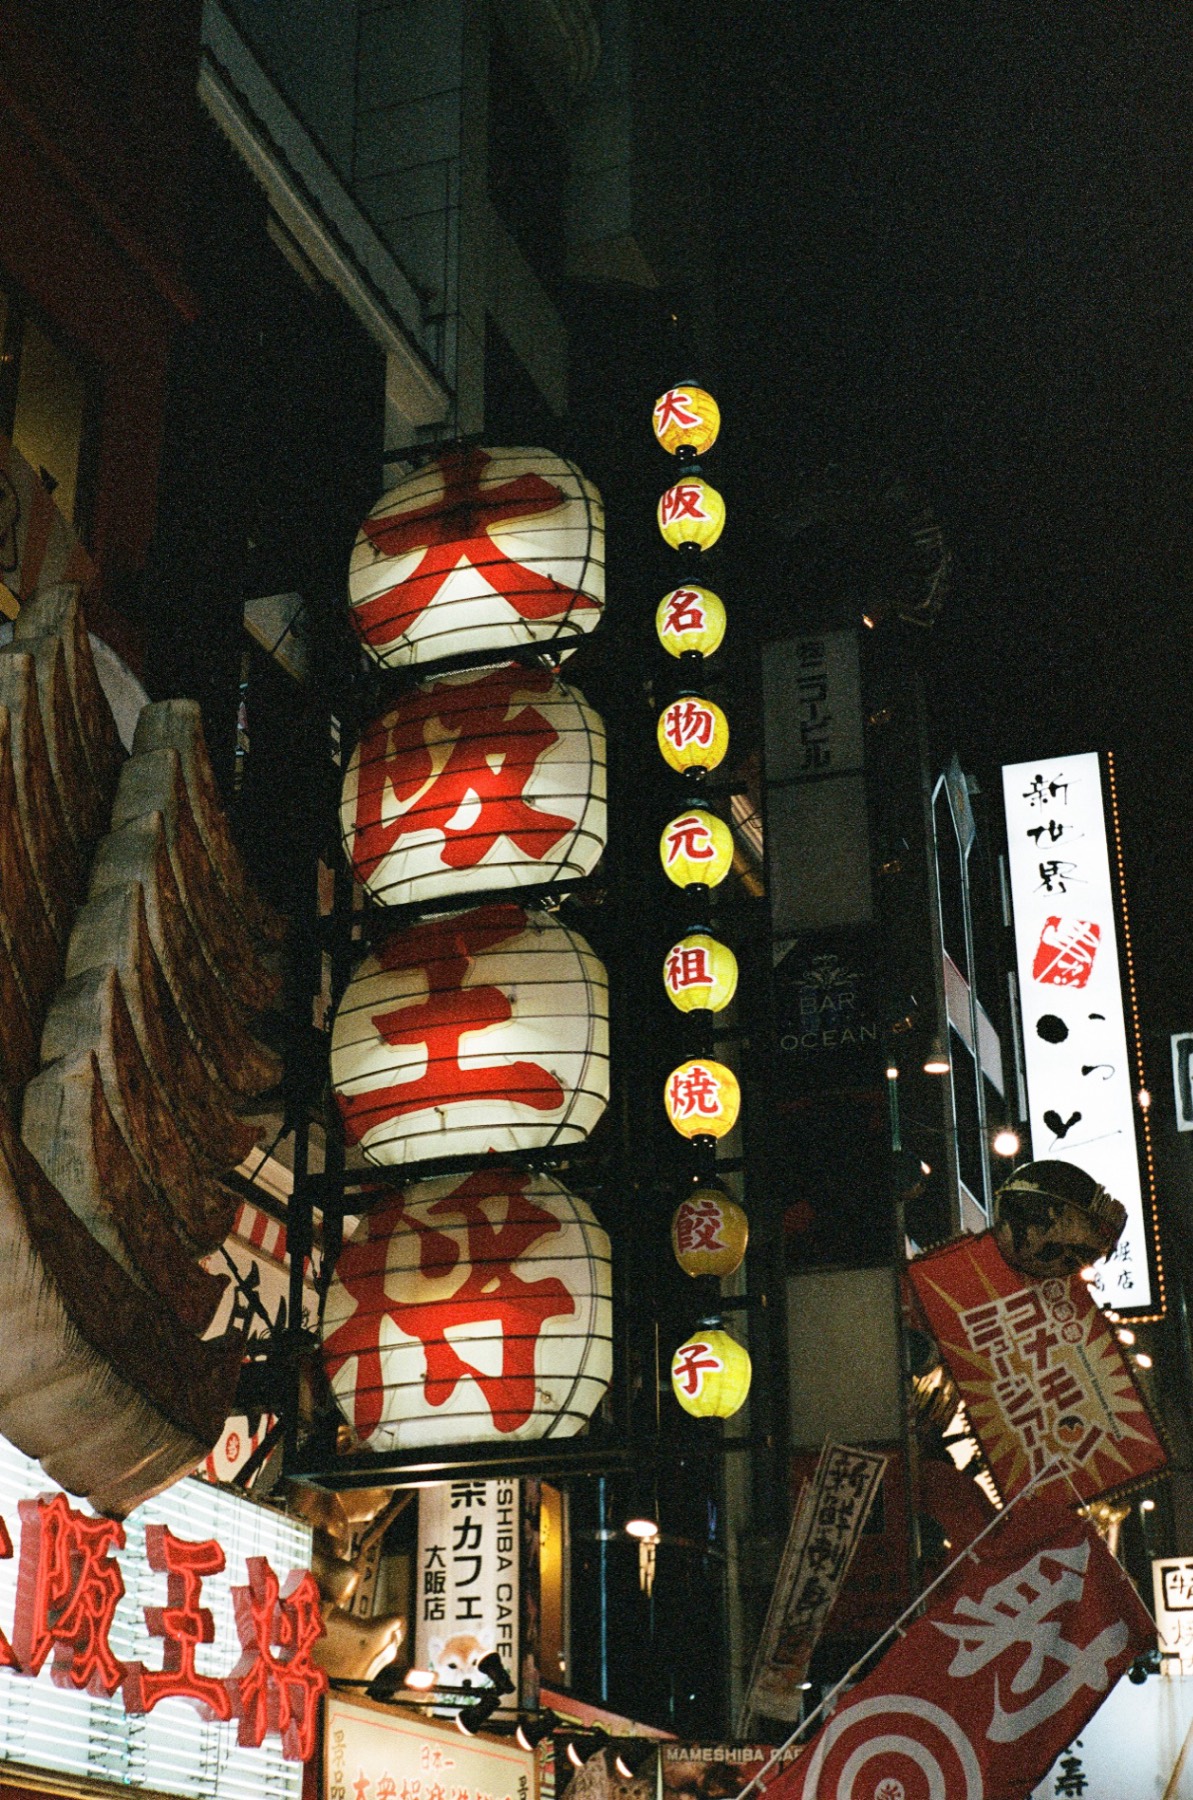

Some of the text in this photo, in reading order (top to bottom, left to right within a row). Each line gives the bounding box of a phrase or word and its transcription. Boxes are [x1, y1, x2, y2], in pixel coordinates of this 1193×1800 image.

[1021, 772, 1087, 897] 新世界
[323, 445, 606, 1442] 大阪王将
[655, 390, 726, 1397] 大阪名物元祖焼餃子
[779, 1023, 877, 1050] OCEAN
[799, 992, 855, 1015] BAR
[0, 1492, 328, 1762] 阪王将
[424, 1545, 447, 1621] 大阪店
[496, 1583, 513, 1658] CAFE
[931, 1541, 1130, 1742] 射
[667, 1748, 764, 1762] MAMESHIBA
